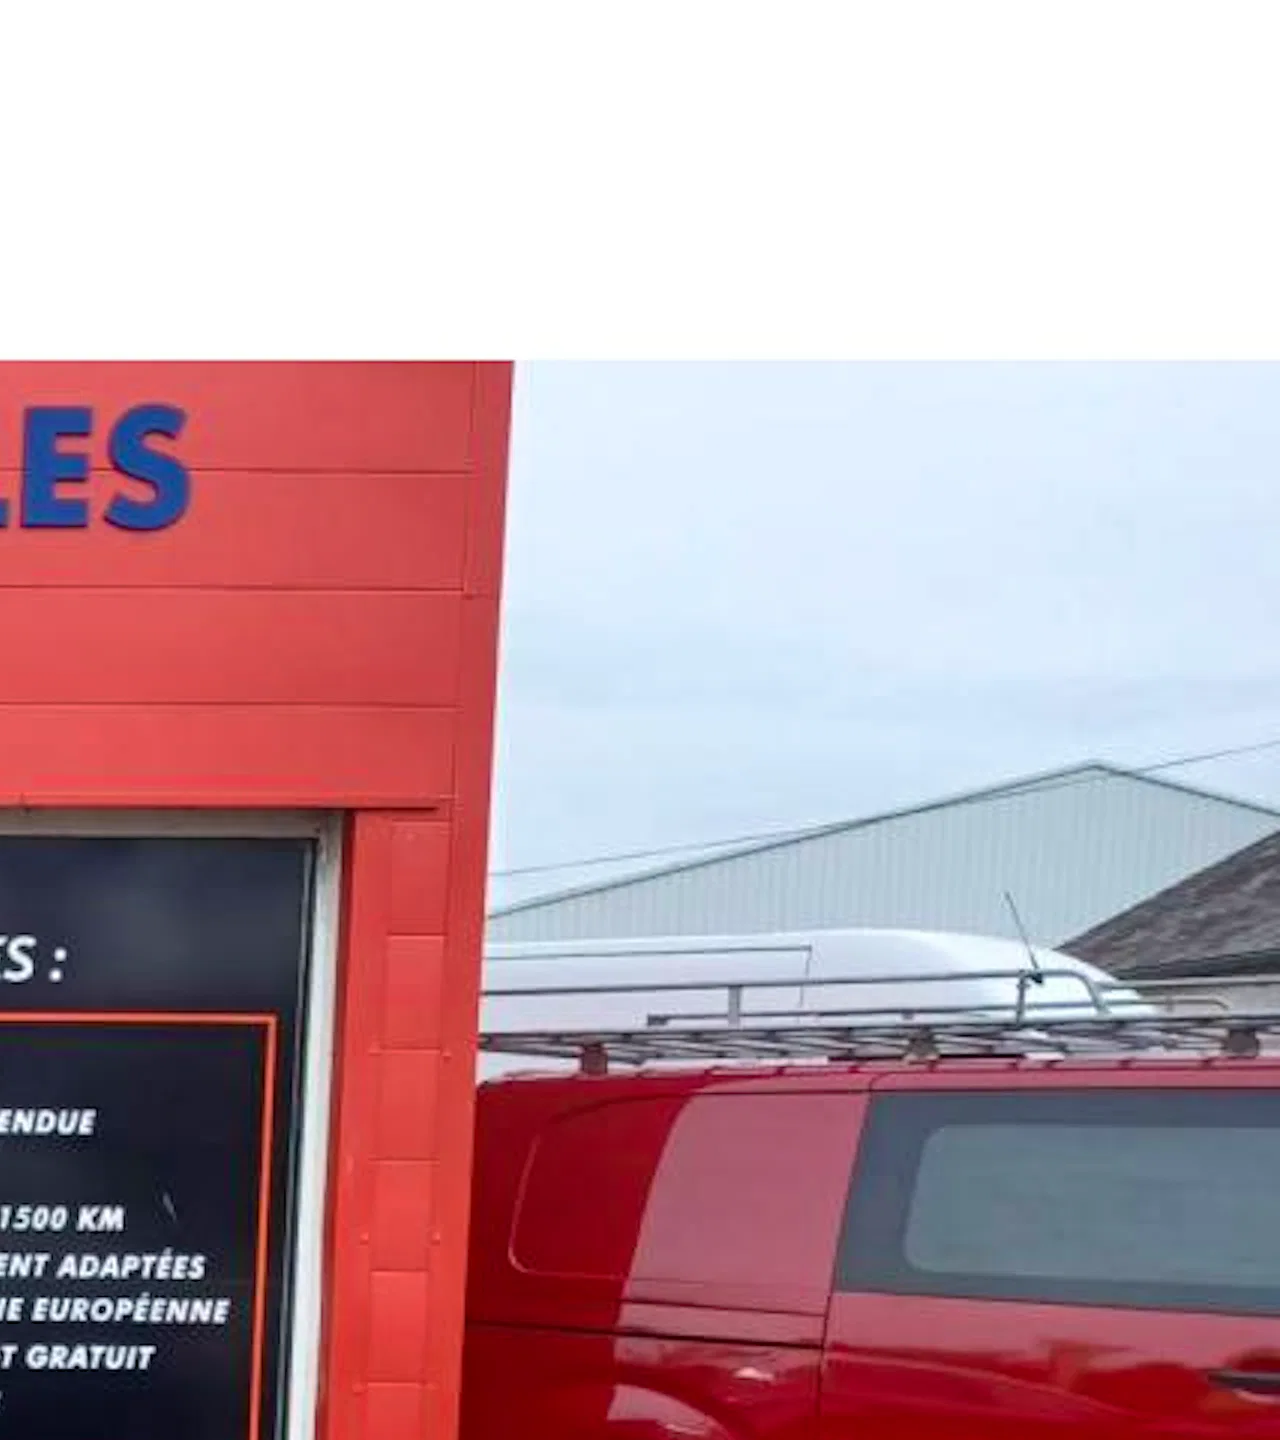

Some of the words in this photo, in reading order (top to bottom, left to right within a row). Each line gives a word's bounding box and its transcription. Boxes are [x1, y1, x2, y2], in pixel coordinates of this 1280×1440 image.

[76, 1206, 125, 1232] KM
[55, 1247, 206, 1280] ADAPTÉES
[30, 1292, 231, 1324] EUROPÉENNE
[25, 1344, 157, 1370] GRATUIT
